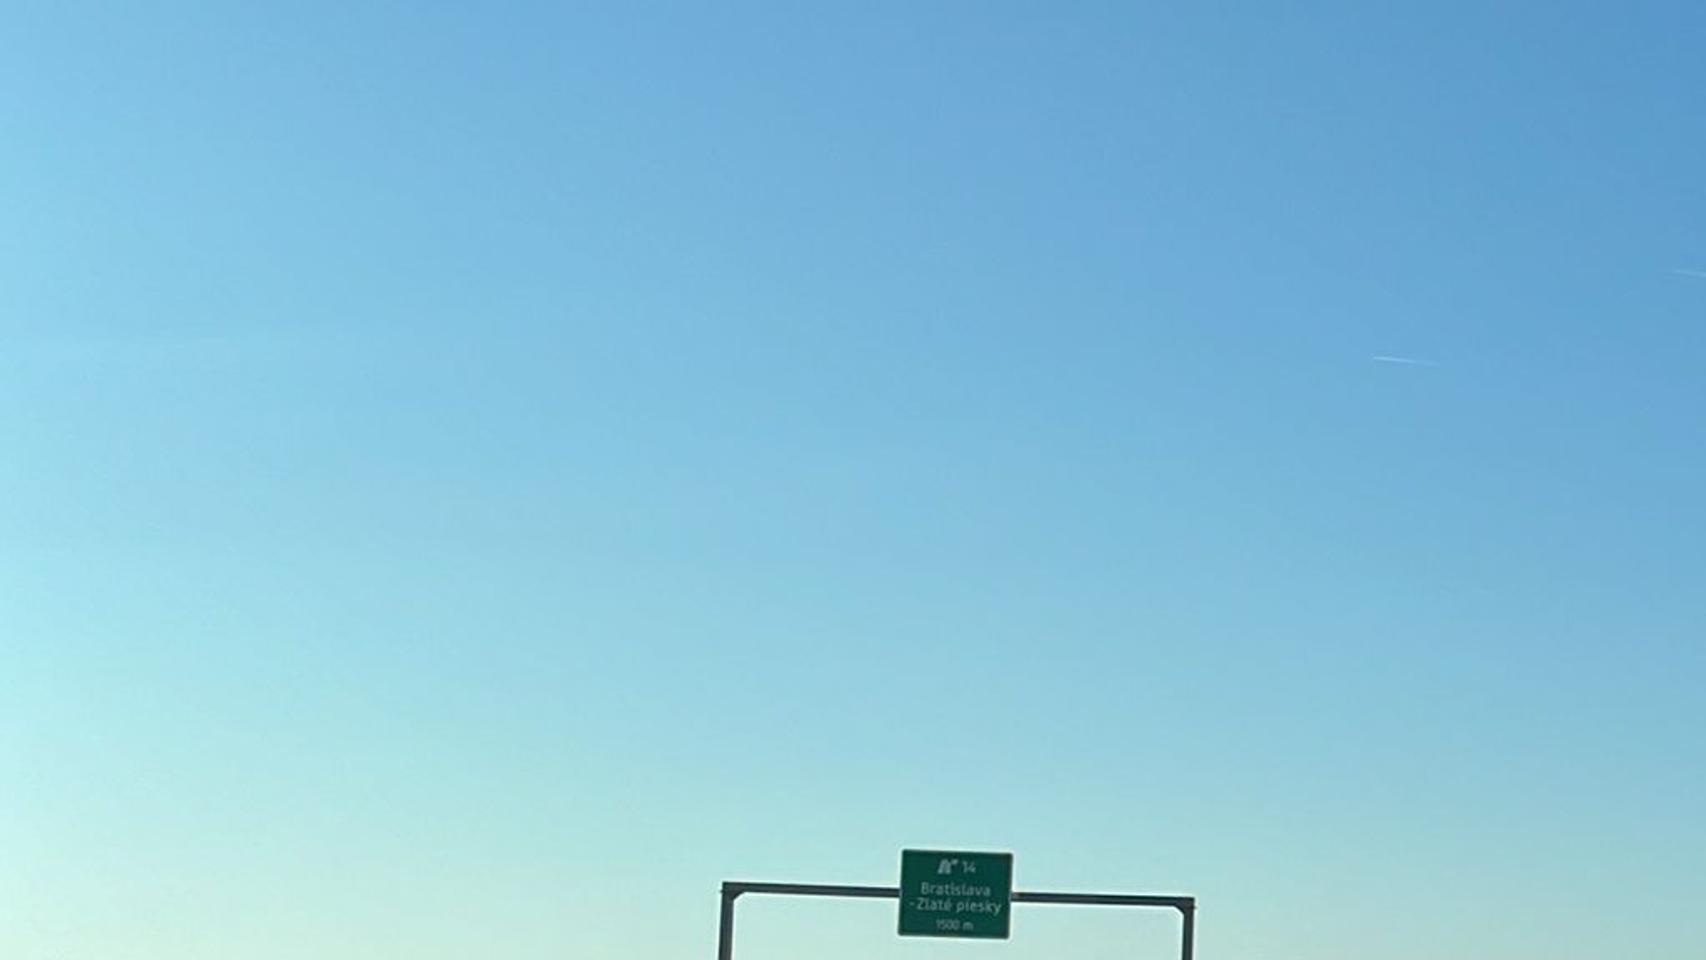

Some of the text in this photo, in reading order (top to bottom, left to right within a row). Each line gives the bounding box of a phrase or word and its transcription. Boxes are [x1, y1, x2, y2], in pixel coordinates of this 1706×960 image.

[962, 861, 976, 873] 14
[921, 882, 991, 897] Bratislava
[956, 899, 1002, 916] piesky
[936, 919, 974, 931] 1500 m
